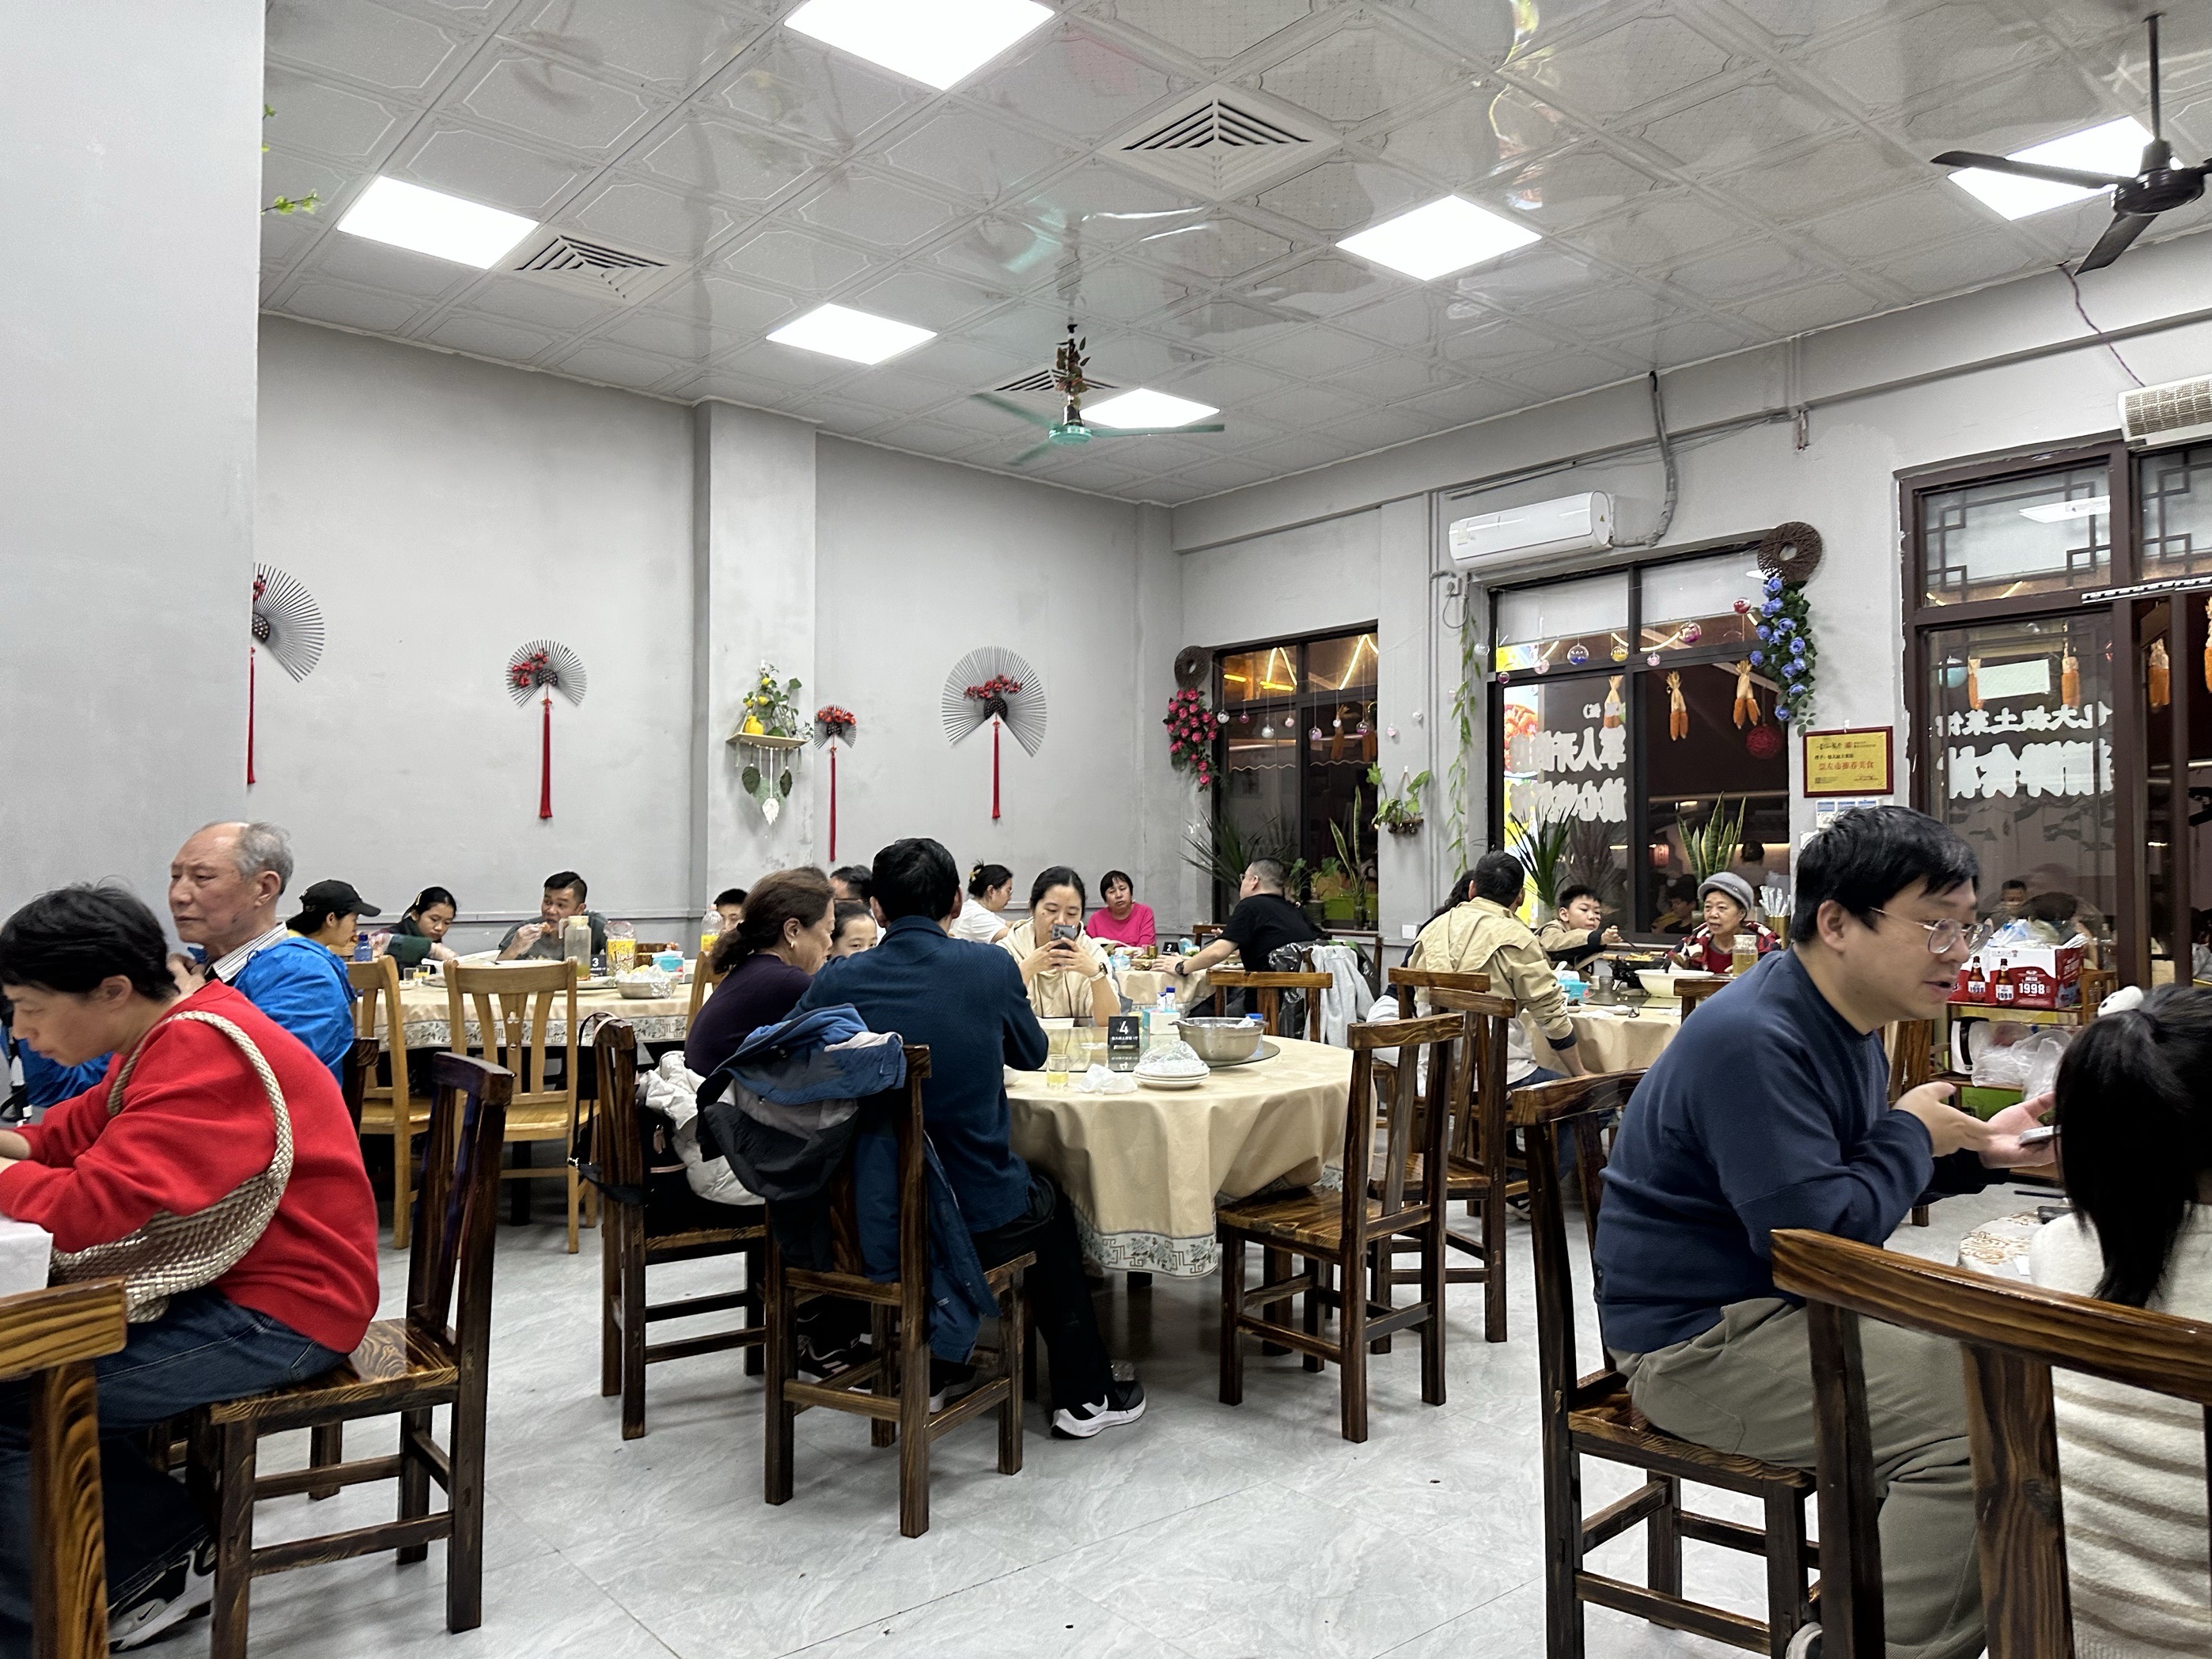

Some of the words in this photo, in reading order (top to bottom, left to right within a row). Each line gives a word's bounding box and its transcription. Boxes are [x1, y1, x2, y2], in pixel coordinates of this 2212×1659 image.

[592, 957, 599, 967] 3
[2018, 983, 2045, 994] 1998
[1119, 1021, 1128, 1035] 4
